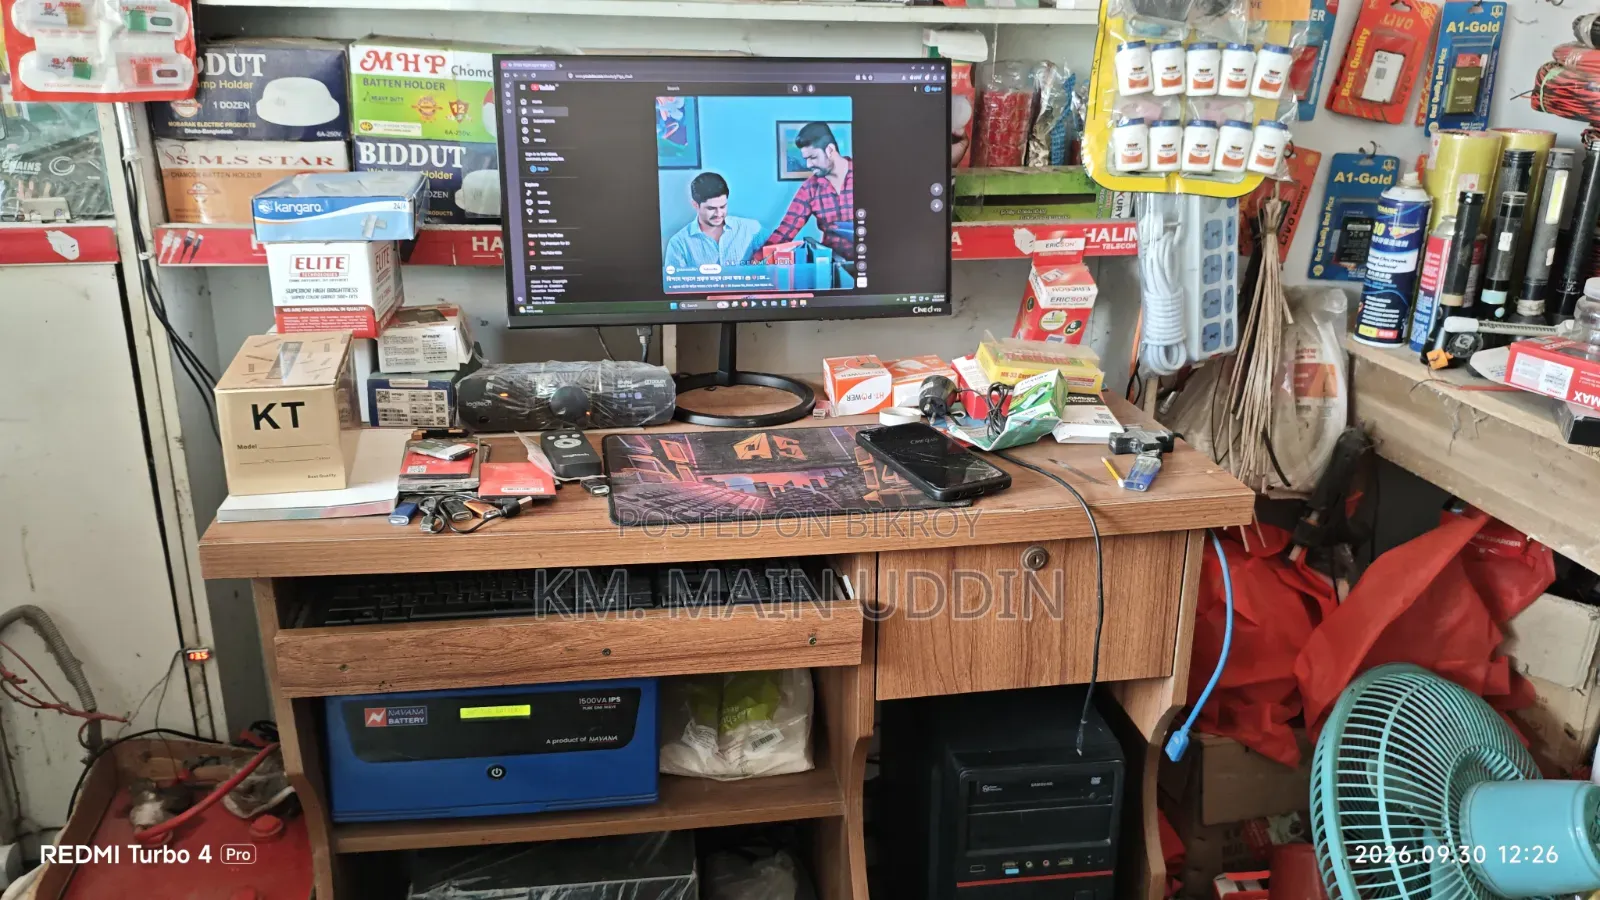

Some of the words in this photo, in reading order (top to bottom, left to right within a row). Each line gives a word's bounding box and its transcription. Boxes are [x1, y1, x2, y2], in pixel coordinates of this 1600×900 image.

[1446, 21, 1500, 33] A1-Gold
[1350, 27, 1372, 68] Quality
[360, 50, 446, 74] MHP
[219, 80, 254, 90] Holder
[362, 78, 402, 88] BATTEN
[404, 80, 446, 91] HOLDER
[452, 104, 466, 114] 12
[176, 155, 249, 165] S.M.S
[258, 155, 335, 166] STAR
[355, 142, 466, 168] BIDDUT
[1334, 171, 1392, 185] A1-Gold
[274, 200, 322, 216] kangaro
[294, 256, 346, 270] ELITE
[376, 247, 390, 272] ELITE
[846, 391, 872, 402] POWER
[466, 400, 493, 410] logitech
[252, 402, 305, 430] KT
[578, 697, 608, 705] 1500VA
[388, 708, 425, 716] NAVANA
